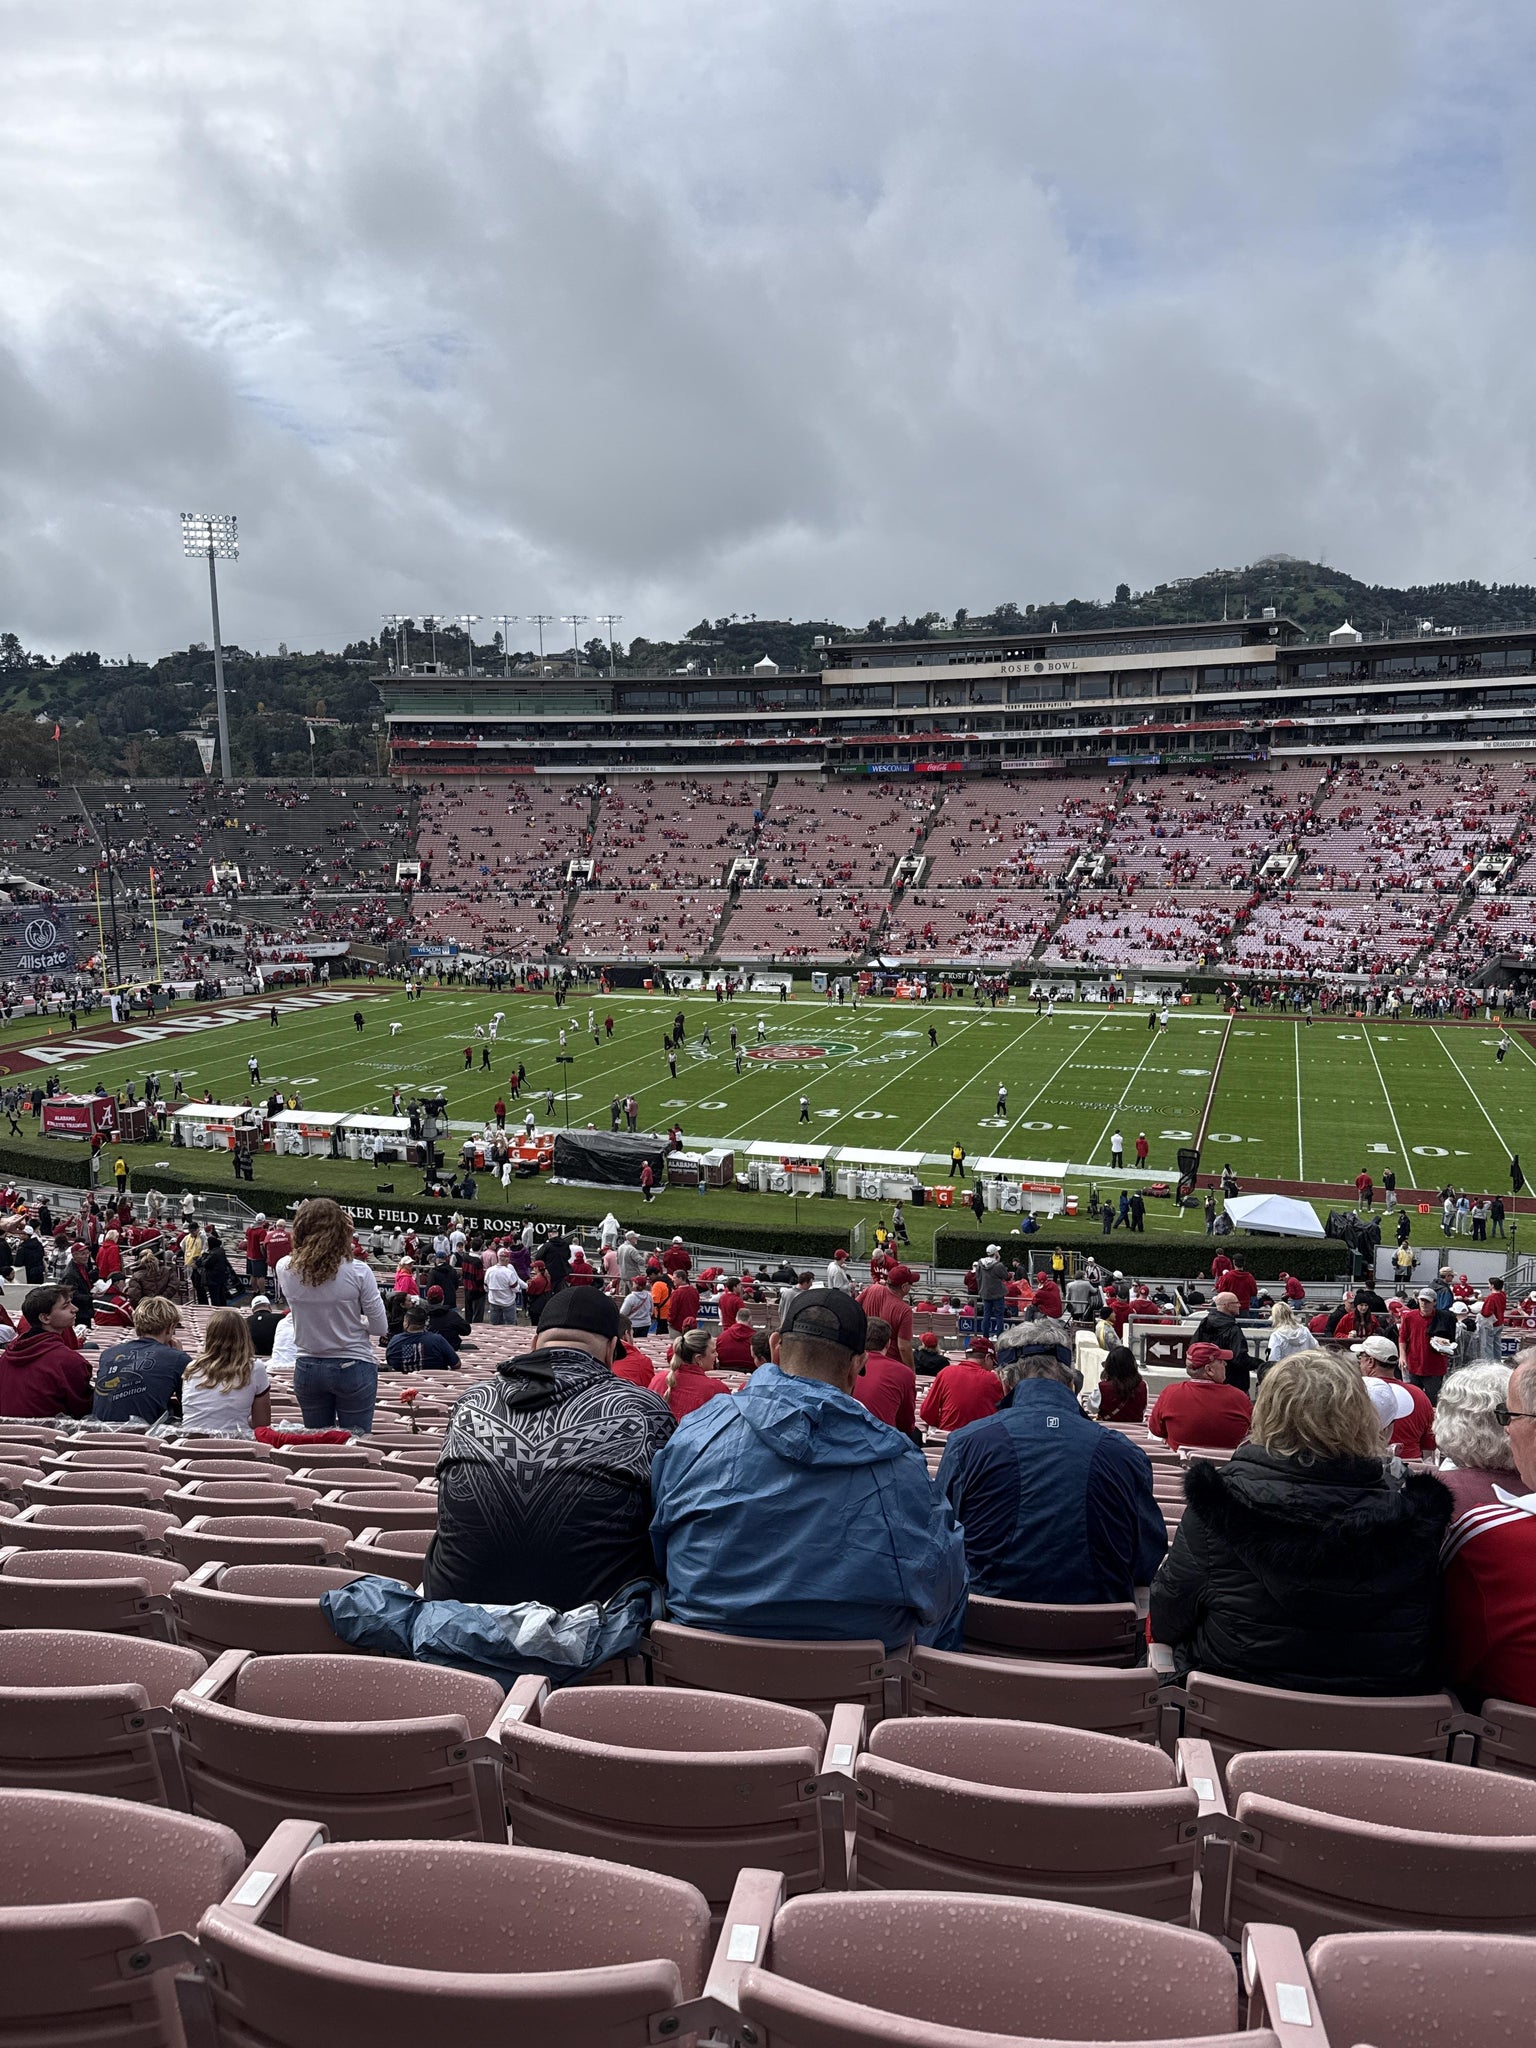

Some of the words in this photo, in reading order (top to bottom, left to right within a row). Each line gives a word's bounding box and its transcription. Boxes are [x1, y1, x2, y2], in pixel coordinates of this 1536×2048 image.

[1001, 665, 1030, 673] ROSE
[1048, 662, 1078, 671] BOWL
[872, 765, 902, 773] WESCOM
[17, 951, 67, 969] Allstate
[19, 990, 379, 1065] ALABAMA
[659, 1098, 729, 1110] 50
[813, 1108, 884, 1120] 40
[976, 1117, 1054, 1131] 30
[1158, 1129, 1243, 1144] 20
[511, 1149, 520, 1159] G
[1366, 1142, 1450, 1157] 10
[668, 1160, 698, 1169] ALABAMA
[939, 1192, 948, 1202] G
[1419, 1204, 1429, 1213] 10
[340, 1205, 374, 1220] EKER
[378, 1209, 419, 1223] FIELD
[424, 1213, 443, 1226] AT
[484, 1218, 521, 1233] ROSE
[1173, 1343, 1183, 1359] 1
[108, 1365, 118, 1374] 19
